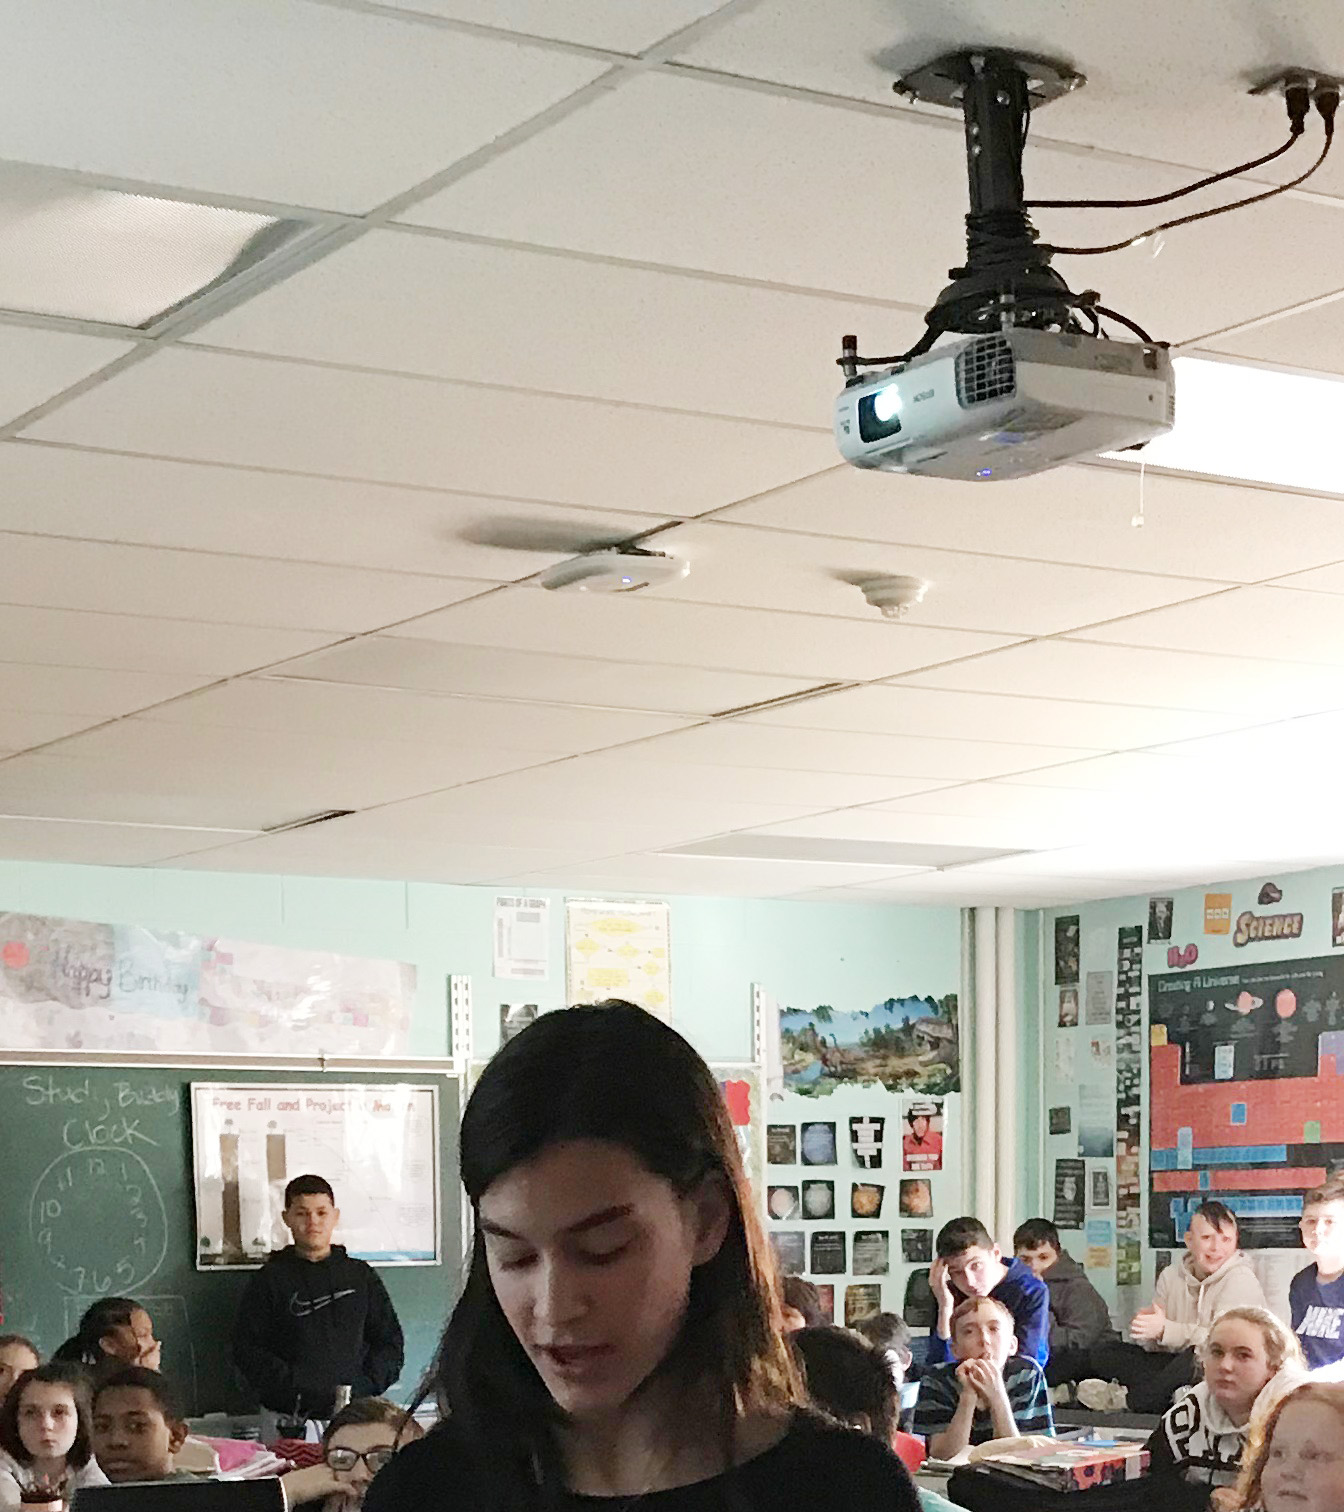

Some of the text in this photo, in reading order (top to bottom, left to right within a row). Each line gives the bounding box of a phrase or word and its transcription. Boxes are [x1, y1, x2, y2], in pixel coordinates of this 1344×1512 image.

[51, 943, 191, 1004] Happy Birthday
[212, 1097, 243, 1112] Free
[247, 1097, 271, 1112] Fall
[276, 1097, 301, 1112] and
[63, 1116, 161, 1149] Clock
[39, 1199, 62, 1224] 10
